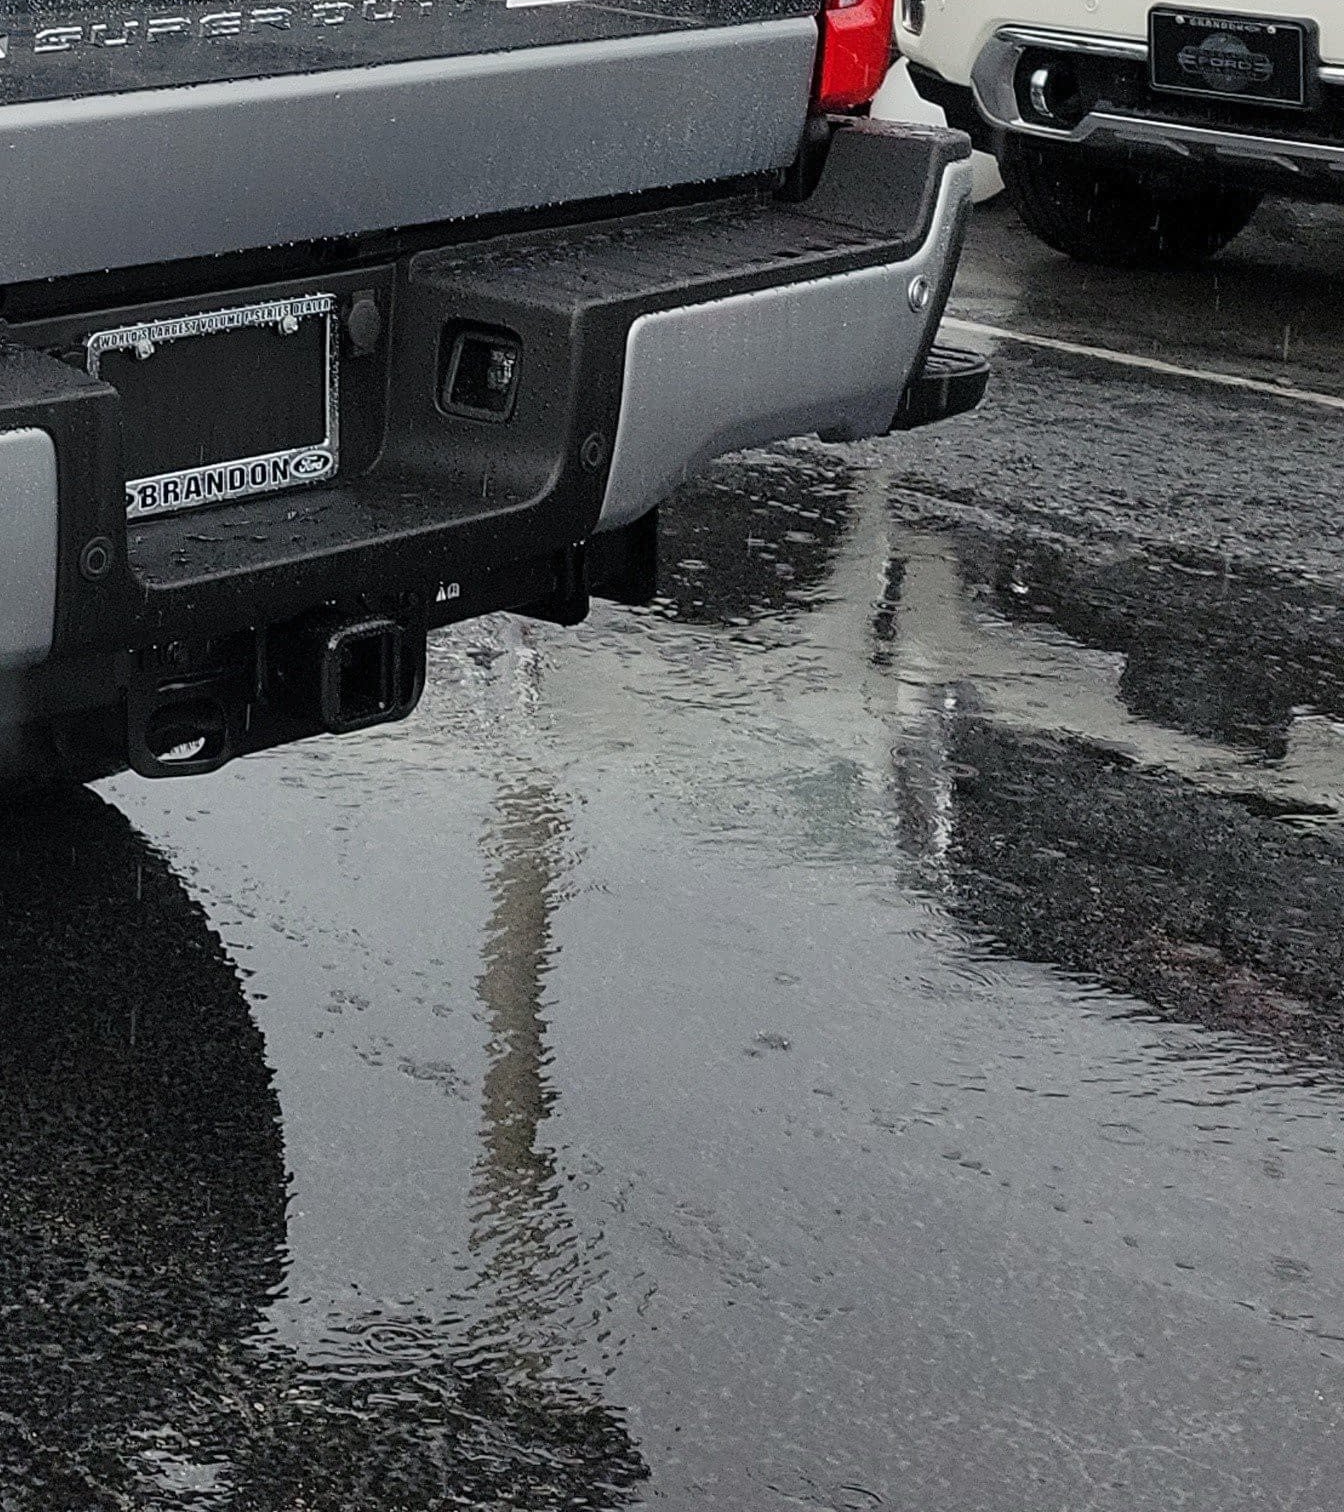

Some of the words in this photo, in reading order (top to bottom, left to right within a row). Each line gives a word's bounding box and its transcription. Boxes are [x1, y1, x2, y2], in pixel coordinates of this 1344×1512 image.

[33, 4, 293, 53] SUPER
[100, 328, 148, 348] WORLD'S
[150, 319, 198, 339] LARGEST
[200, 311, 242, 331] VOLUME
[293, 297, 330, 317] DEALER
[137, 456, 290, 511] BRANDON
[298, 455, 325, 474] Ford
